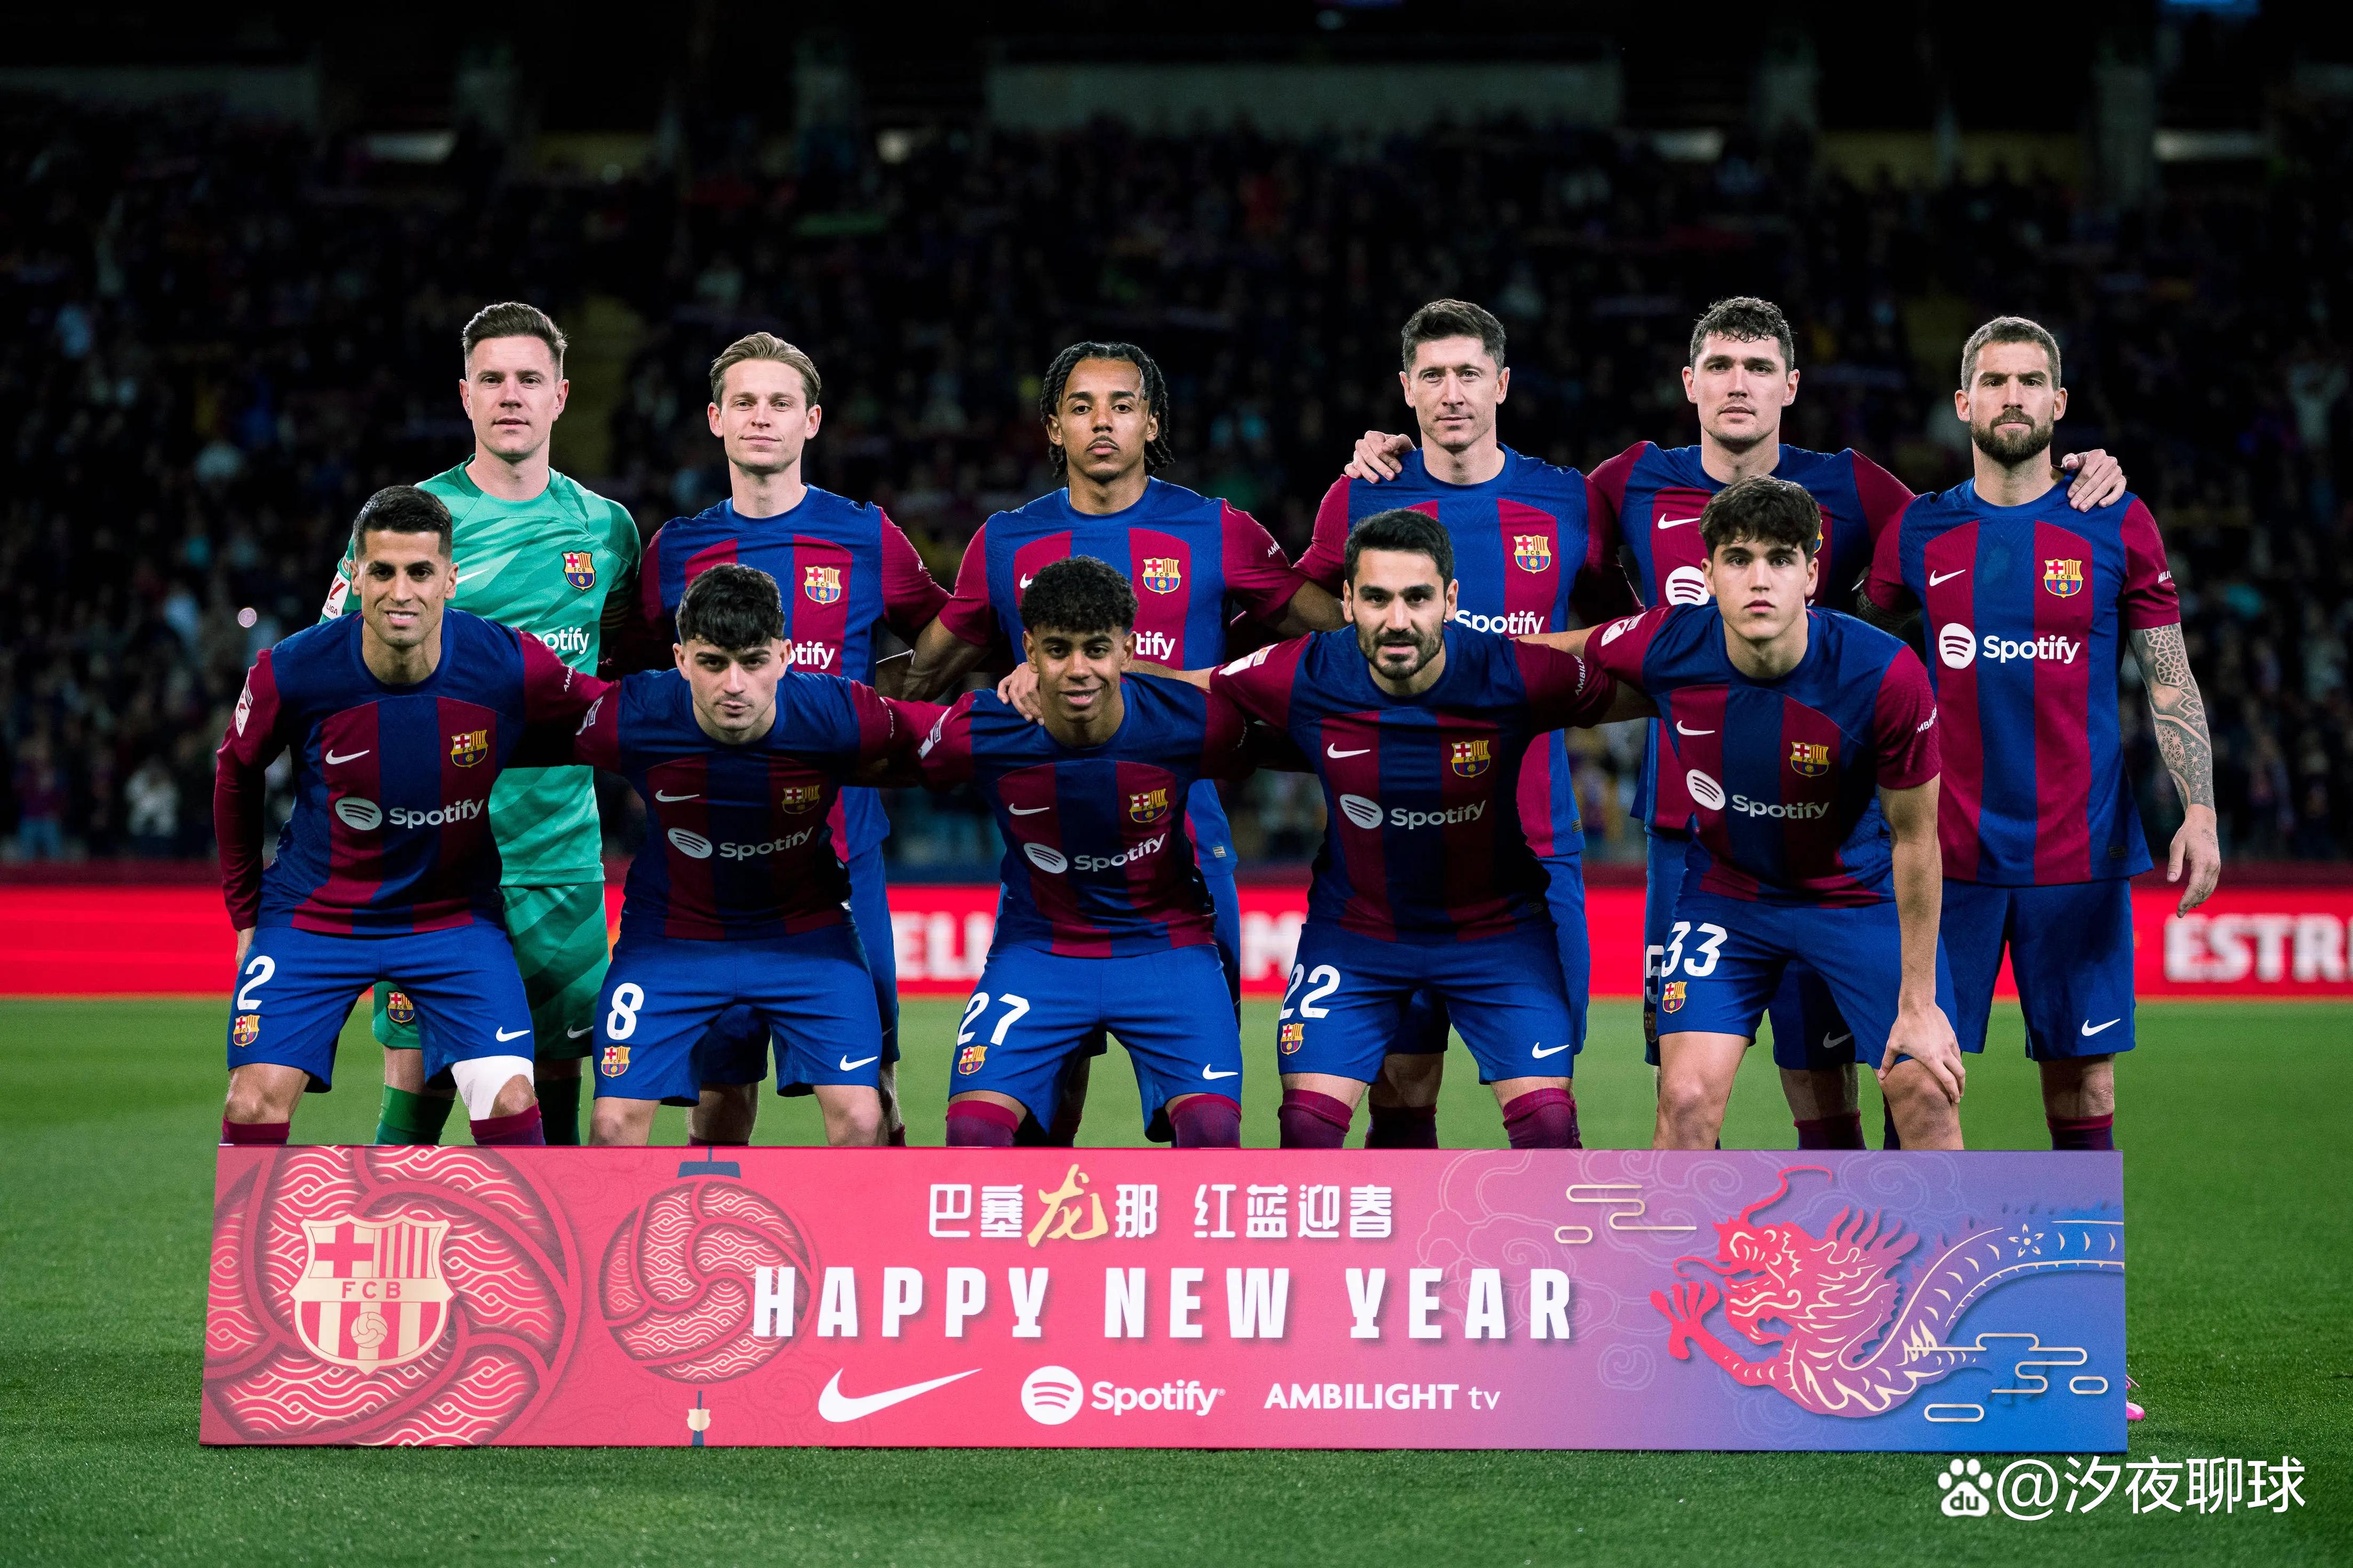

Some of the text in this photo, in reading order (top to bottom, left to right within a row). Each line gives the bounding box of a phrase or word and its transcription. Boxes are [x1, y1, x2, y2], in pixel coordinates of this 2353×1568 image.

[1982, 634, 2081, 665] Spotify
[389, 799, 485, 829] Spotify
[1390, 800, 1486, 830] Spotify
[1732, 794, 1830, 819] Spotify
[719, 826, 814, 861] Spotify
[1074, 833, 1166, 872] Spotify
[1661, 921, 1728, 977] 33
[2164, 913, 2353, 983] ESTR
[237, 955, 276, 1010] 2
[1279, 964, 1341, 1020] 22
[606, 982, 644, 1040] 8
[957, 992, 1030, 1046] 27
[929, 1164, 1392, 1247] 巴塞龙那 红蓝迎春
[342, 1281, 401, 1299] FCB
[753, 1267, 1570, 1339] HAPPY NEW YEAR
[1264, 1383, 1460, 1410] AMBILIGHT
[1468, 1386, 1501, 1410] tv
